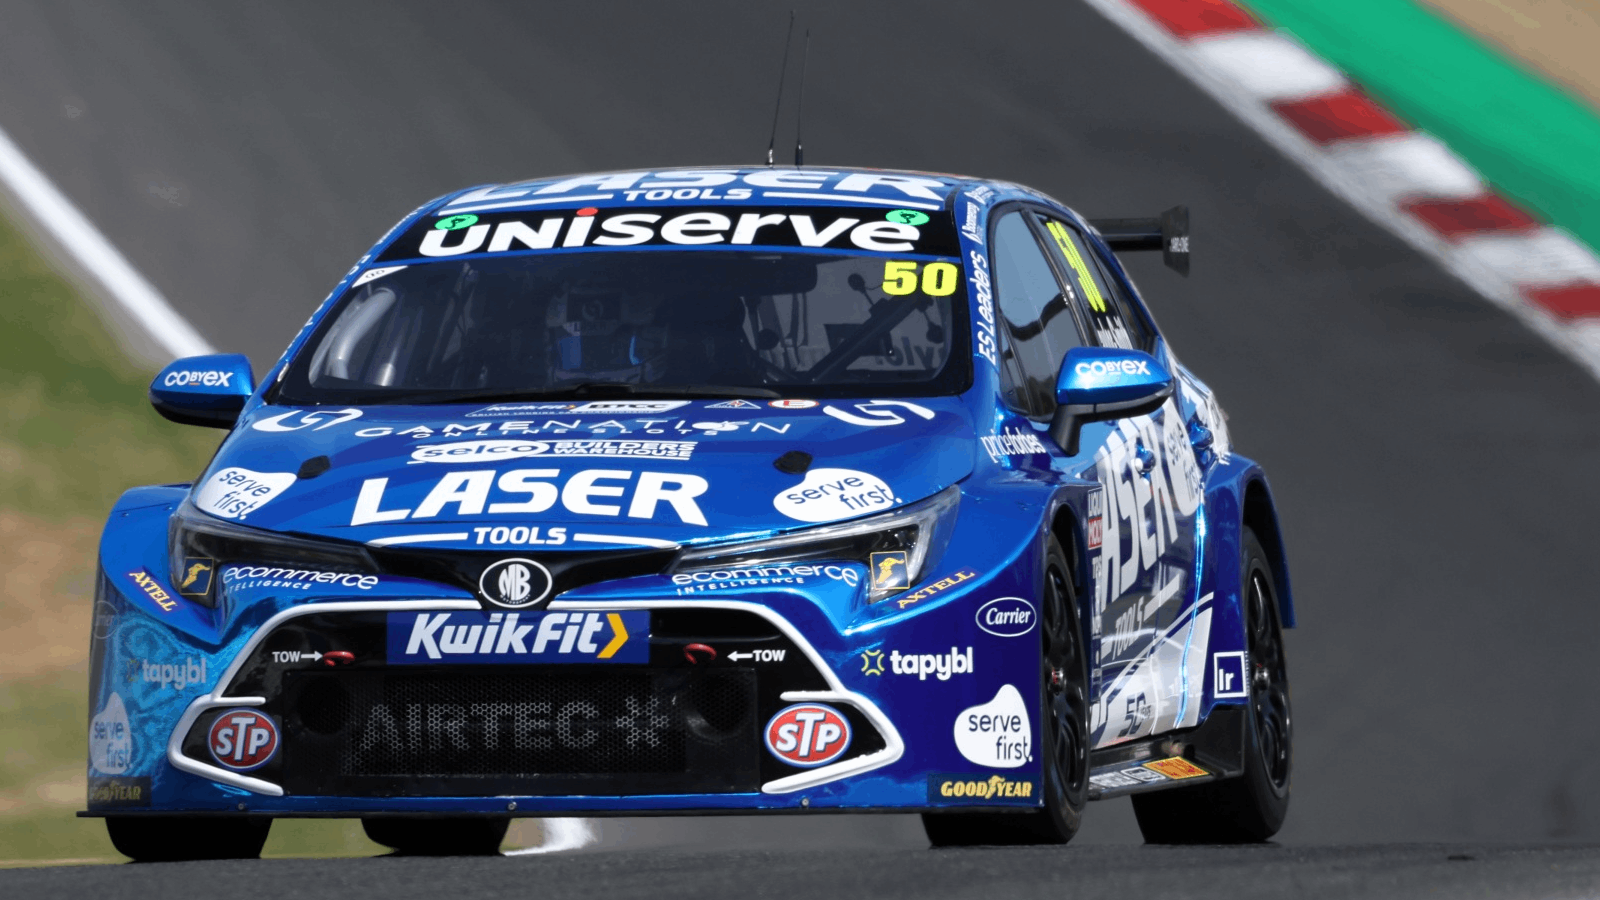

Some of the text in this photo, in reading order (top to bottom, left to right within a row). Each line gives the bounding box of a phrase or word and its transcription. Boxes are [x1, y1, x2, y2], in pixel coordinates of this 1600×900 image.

[446, 170, 946, 205] LASER
[623, 188, 752, 202] TOOLS
[882, 260, 958, 296] 50
[554, 442, 698, 451] BUILDERS
[554, 448, 693, 457] WAREHOUSE
[218, 470, 271, 497] serve
[786, 476, 864, 505] serve
[351, 469, 708, 527] LASER
[474, 527, 567, 545] TOOLS
[222, 566, 379, 590] ecommerce
[498, 563, 531, 601] MB
[672, 564, 858, 587] ecommerce
[677, 577, 805, 595] INTELLIGENCE
[897, 569, 975, 609] AXTELL
[128, 570, 178, 613] AXTELL
[985, 607, 1031, 625] Carrier
[272, 651, 300, 663] TOW
[753, 649, 786, 662] TOW
[890, 647, 973, 680] tapybl
[143, 657, 207, 690] tapybl
[360, 700, 600, 751] AIRTEC
[775, 711, 841, 757] STP
[968, 713, 1022, 732] serve
[215, 717, 270, 761] STP
[940, 778, 1033, 799] GOODYEAR
